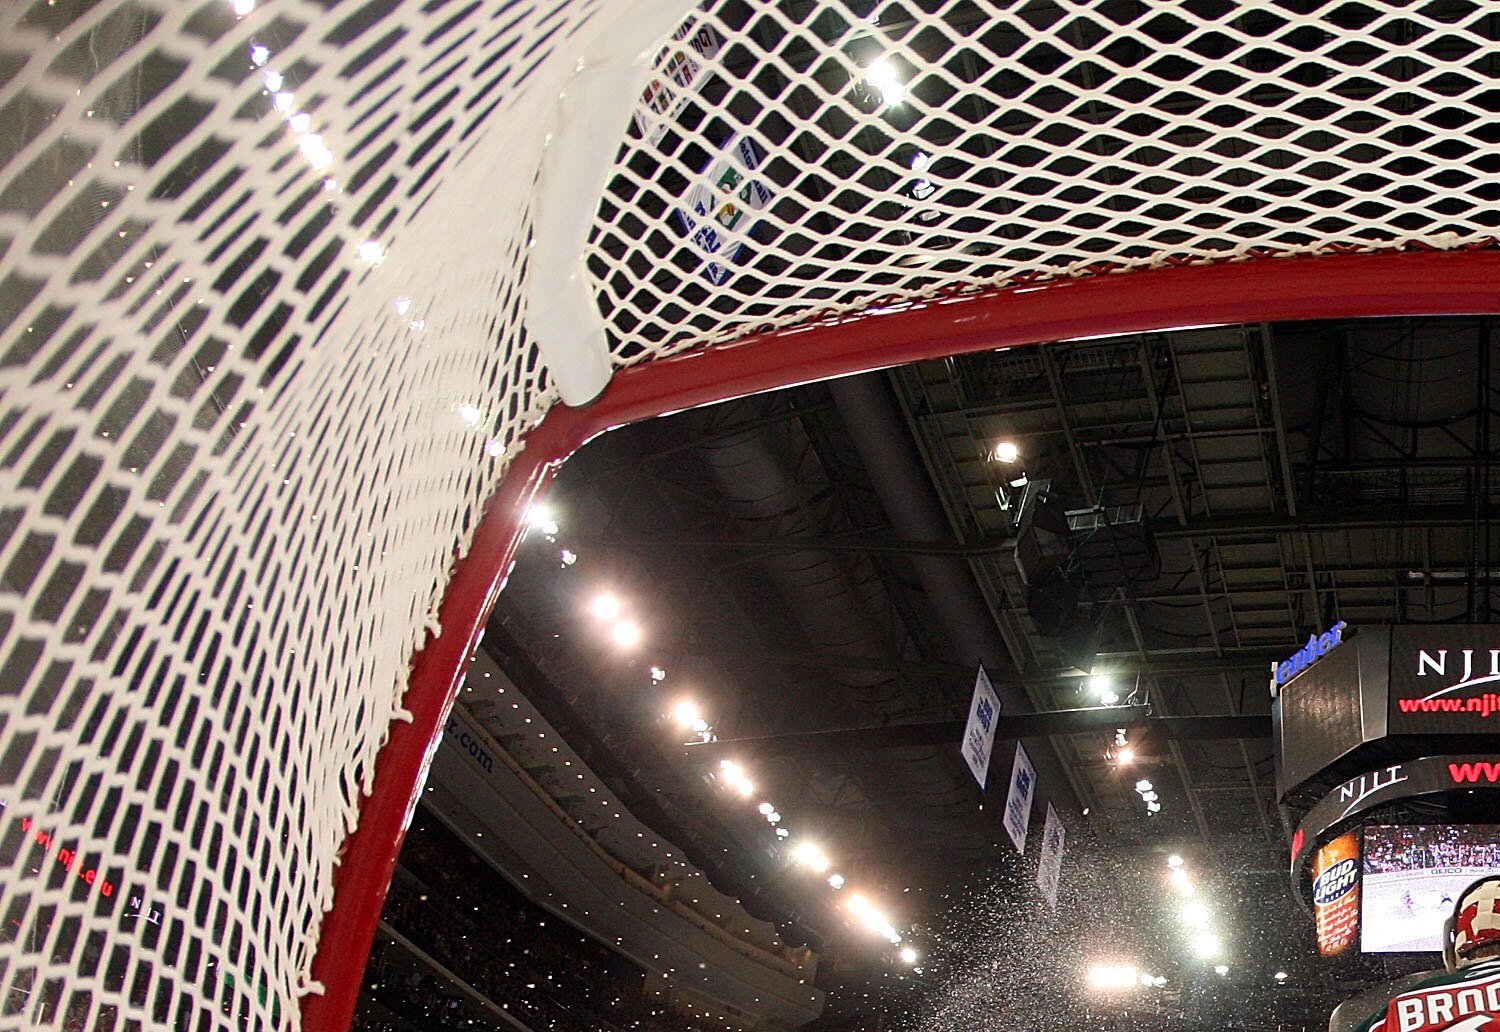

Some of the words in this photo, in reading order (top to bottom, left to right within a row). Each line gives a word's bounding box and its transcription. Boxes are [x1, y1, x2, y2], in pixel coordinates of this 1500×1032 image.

[1340, 766, 1403, 802] NJIT
[1315, 869, 1358, 900] LIGHT
[1320, 860, 1354, 887] BUD
[1431, 867, 1462, 875] GEICO
